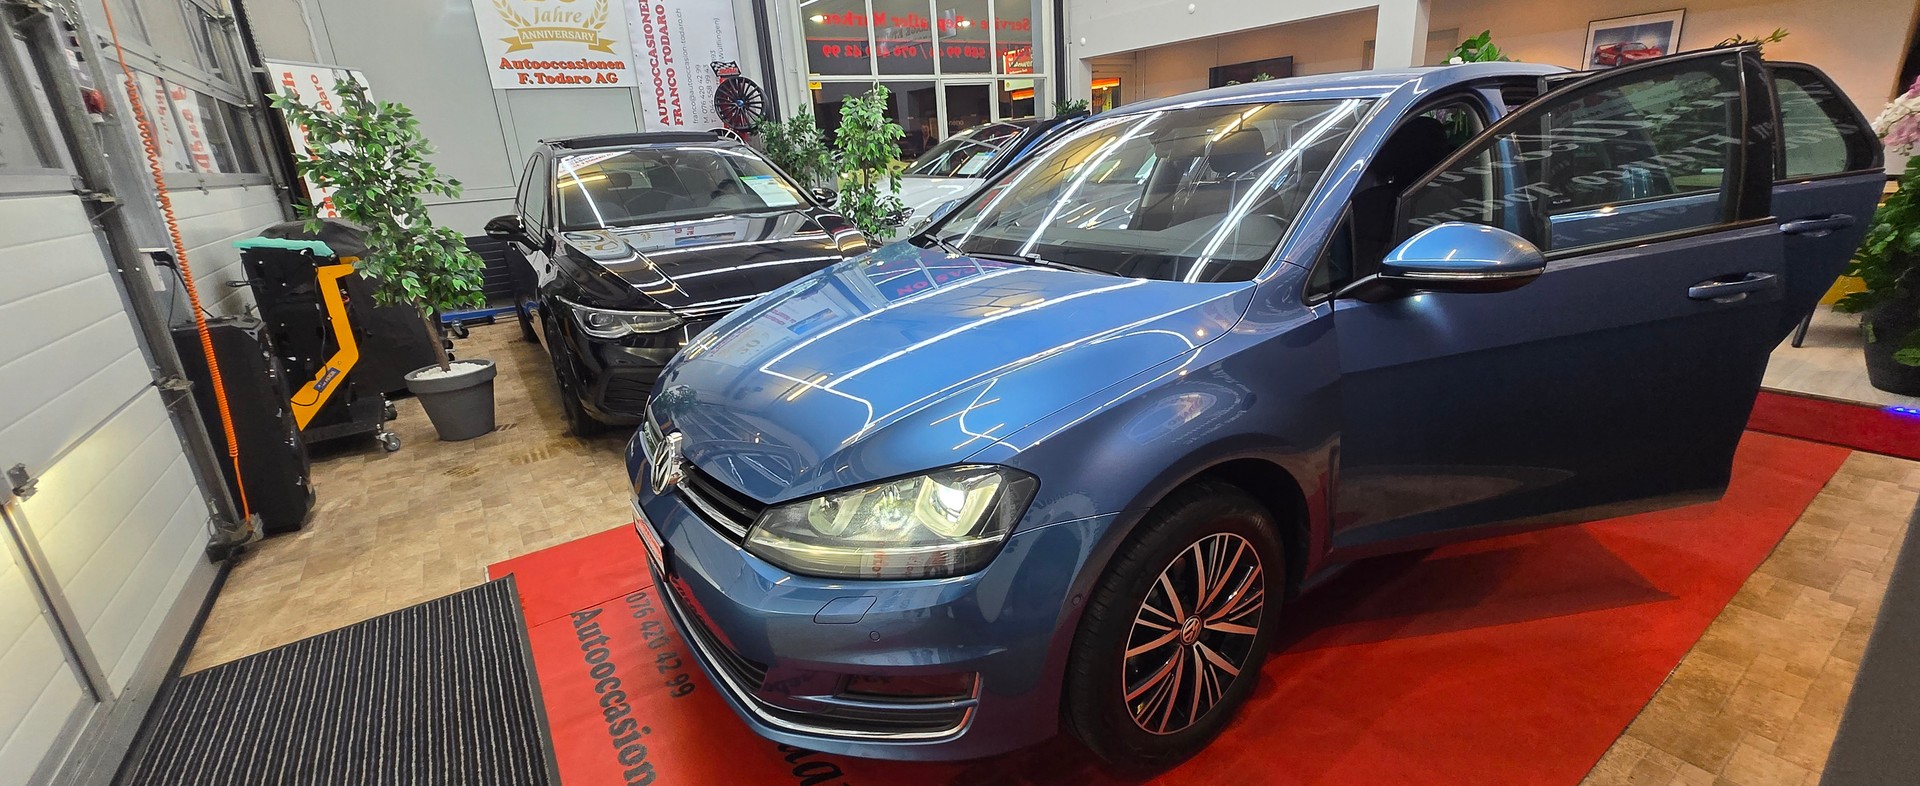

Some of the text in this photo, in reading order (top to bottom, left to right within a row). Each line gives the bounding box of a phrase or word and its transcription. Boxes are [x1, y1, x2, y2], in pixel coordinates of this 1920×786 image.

[533, 5, 582, 25] Jahre
[521, 30, 596, 41] ANNIVERSARY
[500, 57, 626, 70] Autooccasionen
[655, 4, 684, 126] FRANCO TODARO
[517, 72, 619, 85] F. Todaro AG
[625, 591, 655, 619] 076
[641, 620, 671, 649] 420
[655, 652, 683, 674] 42
[665, 673, 696, 698] 99
